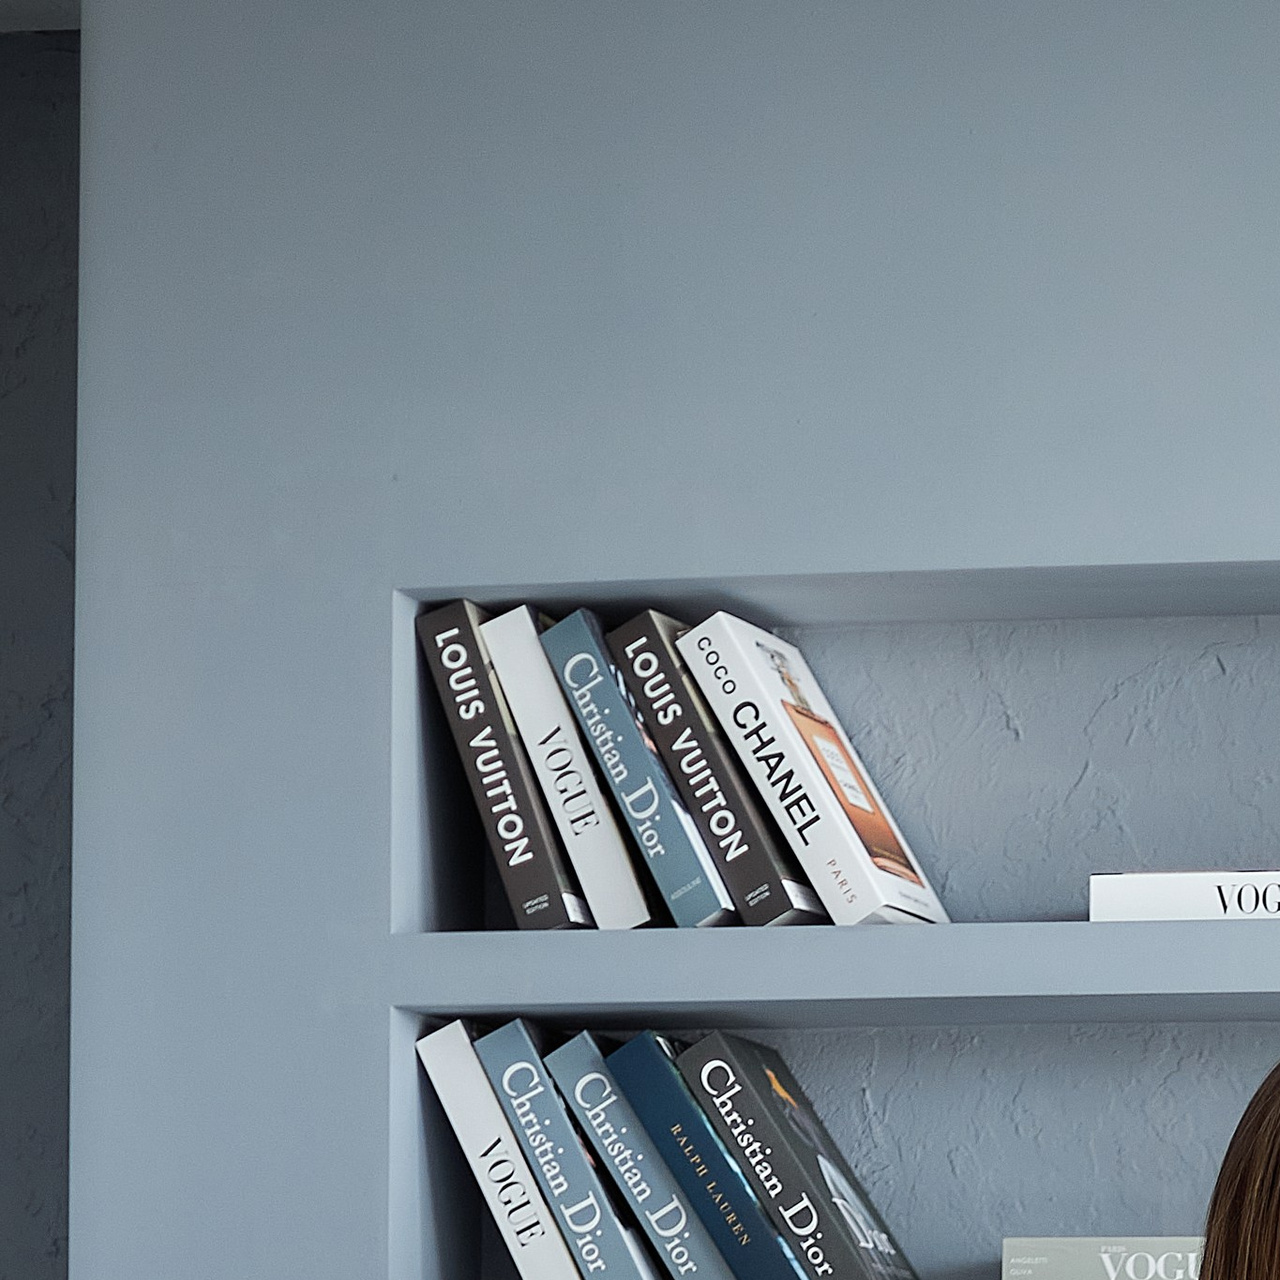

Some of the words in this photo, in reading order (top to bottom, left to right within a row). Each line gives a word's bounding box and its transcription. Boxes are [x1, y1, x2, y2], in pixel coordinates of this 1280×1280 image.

[435, 628, 484, 721] LOUIS
[469, 725, 534, 867] VUITTON
[537, 725, 600, 837] VOGUE
[563, 651, 629, 784] Christian
[620, 775, 665, 859] Dior
[625, 636, 683, 727] LOUIS
[671, 727, 750, 863] VUITTON
[697, 636, 738, 695] COCO
[732, 700, 823, 846] CHANEL
[827, 859, 857, 904] PARIS
[479, 1136, 547, 1248] VOGUE
[501, 1059, 569, 1198] Christian
[559, 1189, 608, 1275] Dior
[573, 1070, 653, 1204] Christian
[645, 1195, 698, 1277] Dior
[669, 1122, 710, 1180] RALPH
[706, 1180, 752, 1247] LAUREN
[700, 1058, 784, 1199] Christian
[778, 1191, 835, 1279] Dior
